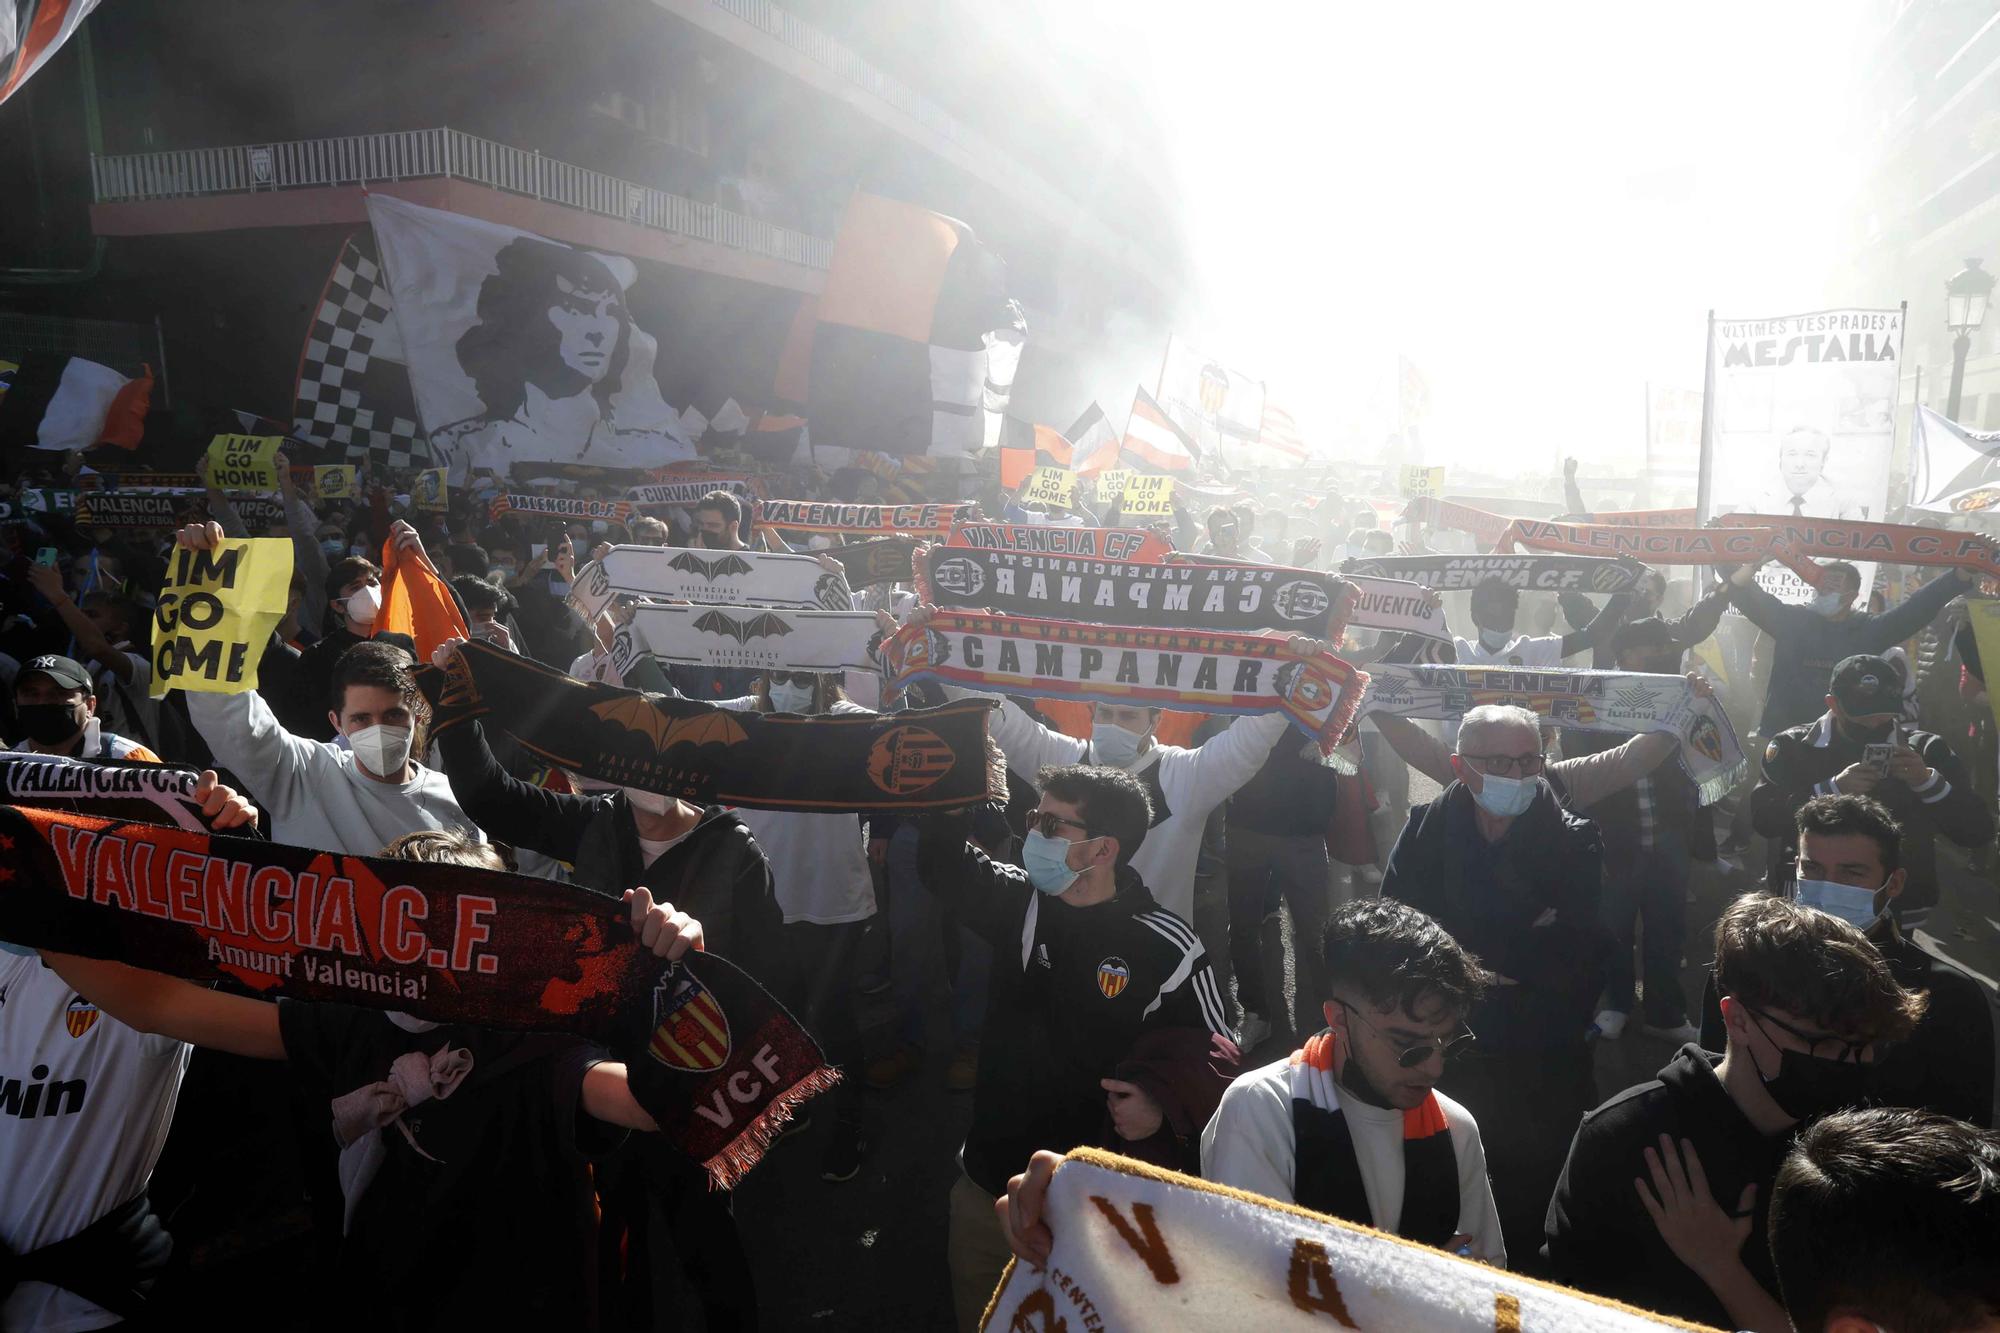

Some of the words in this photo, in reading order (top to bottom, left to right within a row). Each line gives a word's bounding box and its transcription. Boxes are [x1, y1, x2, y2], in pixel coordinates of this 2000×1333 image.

[1796, 314, 1886, 332] VESPRADES
[1723, 333, 1895, 368] MESTALLA
[227, 437, 262, 453] LIM
[225, 453, 251, 468] GO
[214, 470, 268, 487] HOME
[1041, 468, 1063, 481] LIM
[1104, 471, 1125, 482] LIM
[1410, 466, 1430, 478] LIM
[1041, 480, 1060, 491] GO
[1107, 481, 1125, 491] GO
[1130, 478, 1164, 490] LIM
[1410, 479, 1428, 488] GO
[506, 494, 584, 514] VALENCIA
[1029, 488, 1068, 505] HOME
[1137, 491, 1156, 500] GO
[86, 497, 175, 514] VALENCIA
[1122, 500, 1172, 513] HOME
[92, 514, 120, 524] CLUB
[121, 515, 137, 525] DE
[761, 502, 882, 528] VALENCIA
[891, 503, 938, 528] C.F.
[962, 525, 1096, 556] VALENCIA
[1104, 530, 1145, 560] CF
[1516, 519, 1715, 555] VALENCIA
[160, 549, 239, 589] IM
[1444, 559, 1538, 569] AMUNT
[1536, 570, 1585, 588] C.F.
[156, 591, 224, 633] GO
[1039, 626, 1279, 657] VALENCIANISTA
[149, 635, 250, 685] OME
[963, 635, 1264, 694] CAMPANAR
[1408, 668, 1605, 697] VALENCIA
[49, 823, 361, 957] VALENCIA
[379, 884, 500, 975] C.F.
[207, 936, 294, 978] Amunt
[303, 961, 429, 1001] Valencia!
[693, 1041, 783, 1131] VCF
